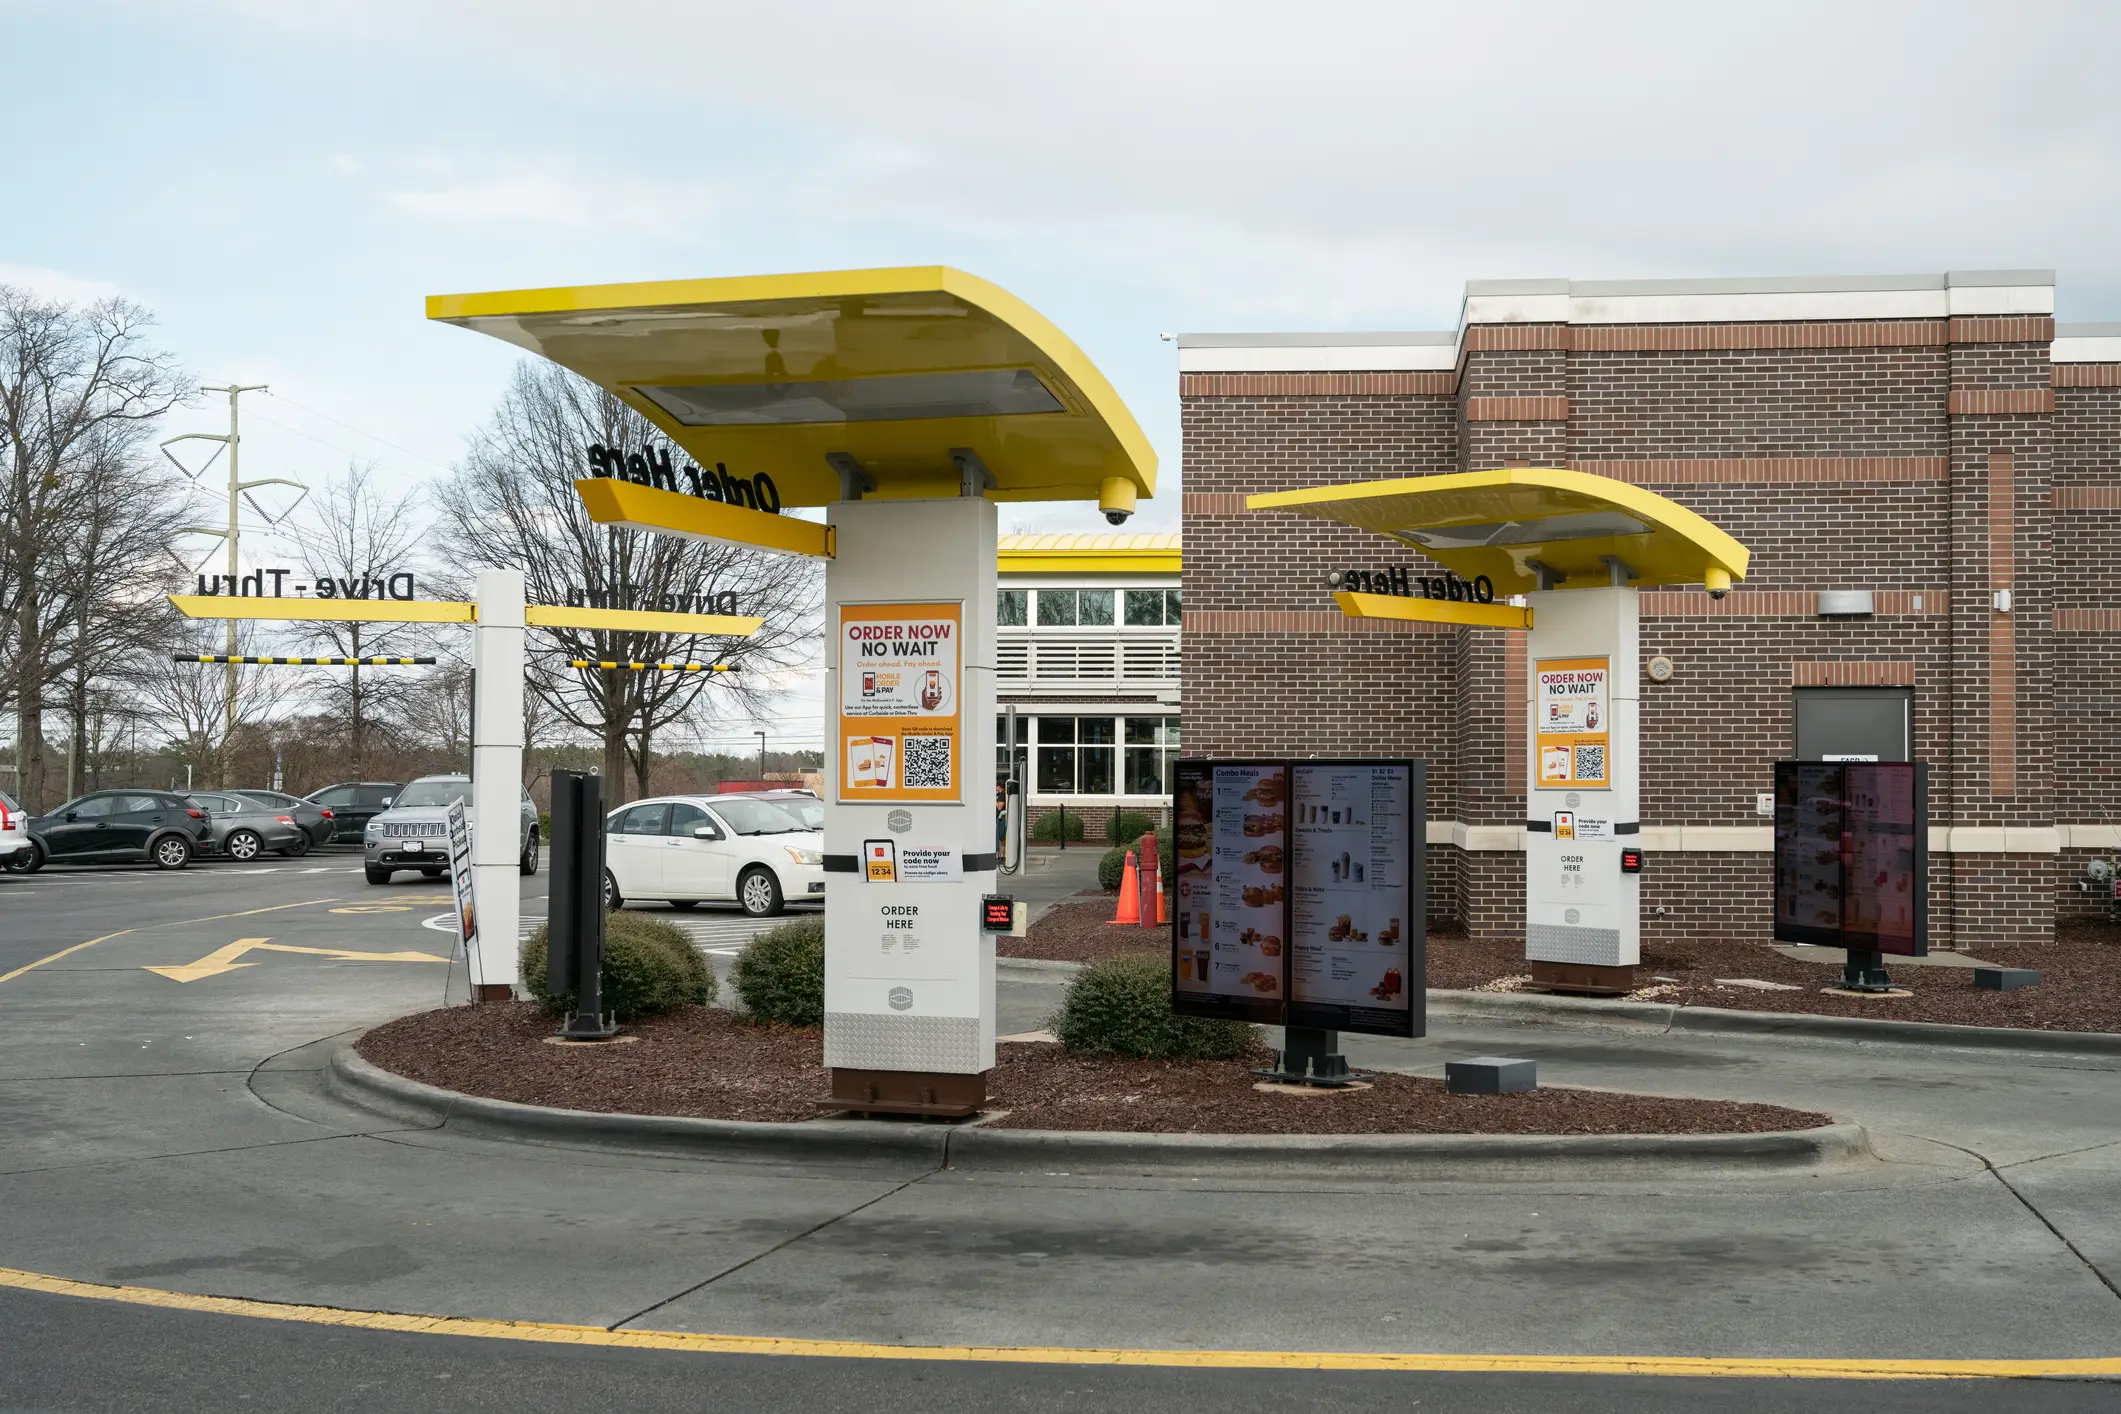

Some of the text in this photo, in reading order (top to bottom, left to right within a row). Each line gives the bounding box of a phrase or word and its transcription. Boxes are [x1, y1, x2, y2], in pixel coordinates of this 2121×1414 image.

[849, 624, 951, 640] ORDER NOW
[861, 641, 938, 657] NO WAIT
[904, 660, 917, 668] Pay
[1541, 672, 1603, 684] ORDER NOW
[1549, 683, 1596, 694] NO WAIT
[1216, 769, 1260, 777] Combo Meals
[1216, 810, 1220, 818] 2
[932, 850, 950, 858] your
[881, 906, 918, 916] ORDER
[886, 920, 914, 929] HERE
